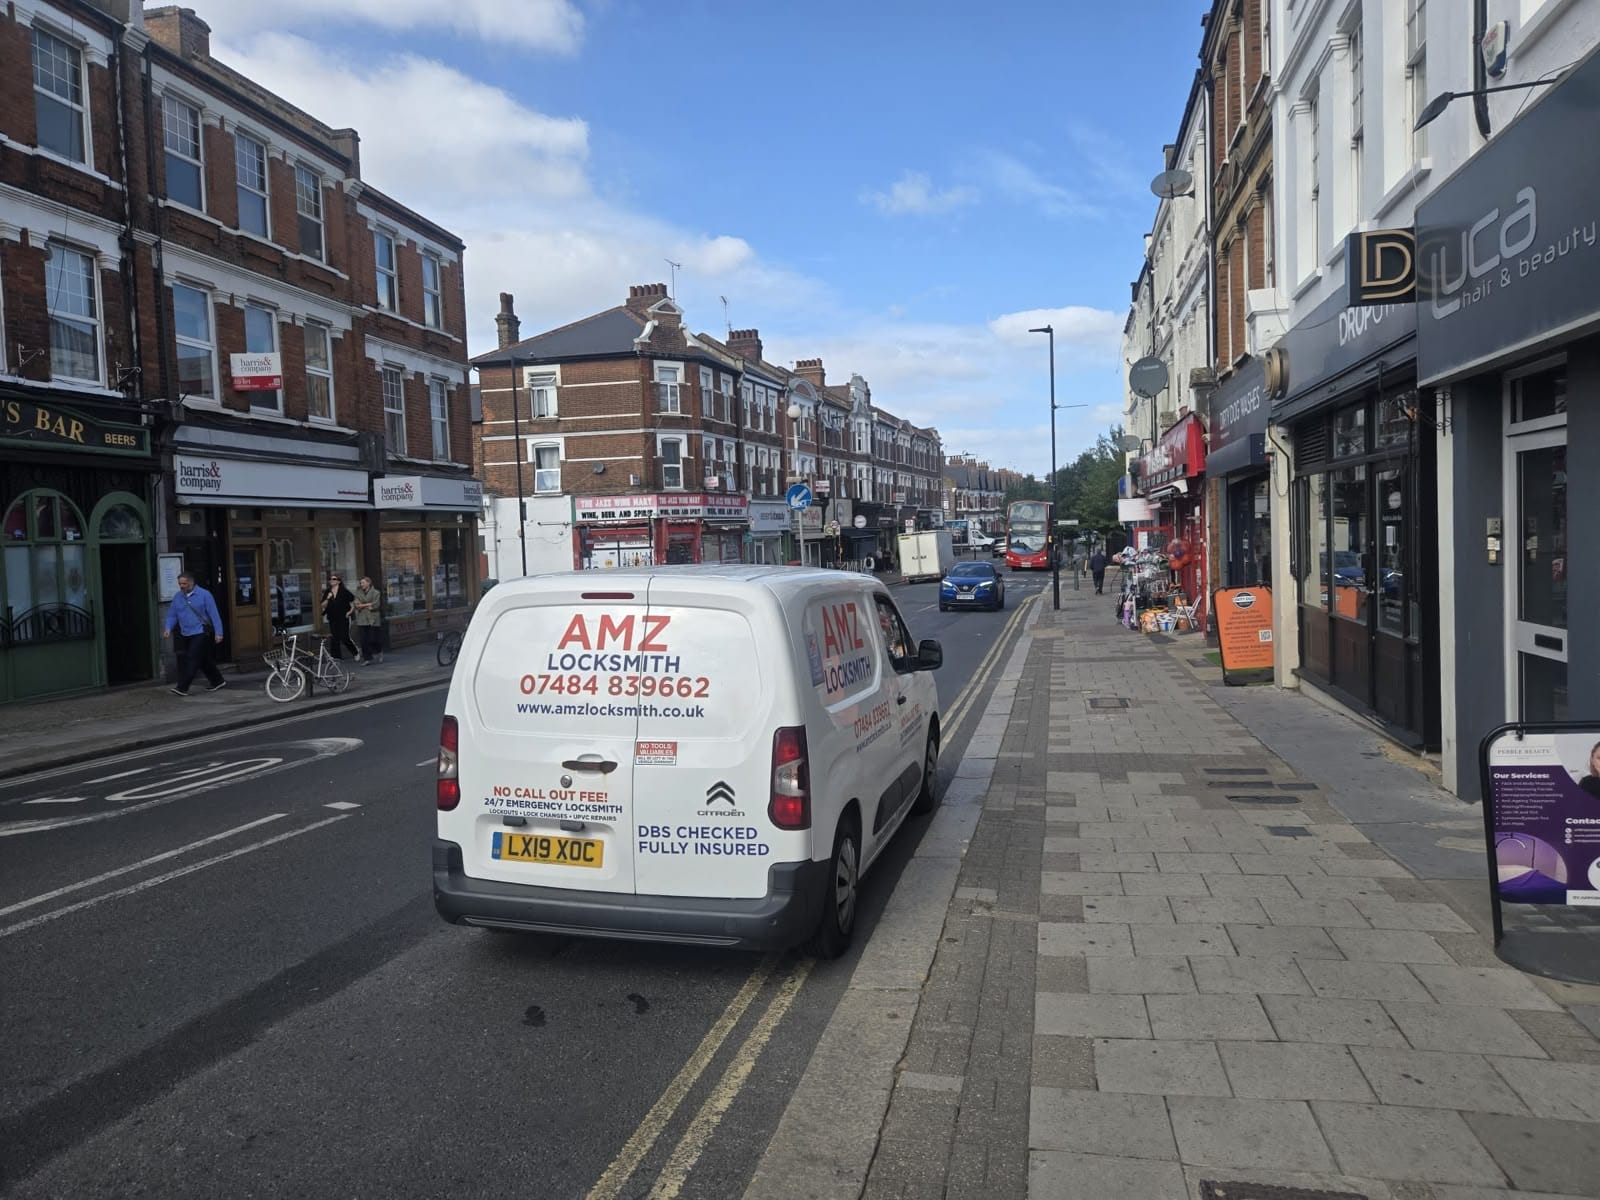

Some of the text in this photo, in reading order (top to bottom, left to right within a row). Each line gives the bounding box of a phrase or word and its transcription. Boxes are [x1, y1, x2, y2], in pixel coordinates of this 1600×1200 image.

[1462, 220, 1597, 308] hair & beauty
[34, 407, 85, 444] BAR
[104, 432, 137, 446] BEERS
[179, 476, 222, 492] company
[381, 493, 414, 503] company
[618, 510, 632, 518] AND
[557, 613, 671, 652] AMZ
[821, 602, 864, 659] AMZ
[547, 653, 681, 673] LOCKSMITH
[824, 655, 873, 694] LOCKSMITH
[520, 674, 710, 698] 07484 839662
[517, 703, 705, 718] www.amzlocksmith.co.uk
[493, 786, 608, 803] NO CALL OUT FEE!
[484, 797, 623, 814] 24/7 EMERGENCY LOCKSMITH
[489, 808, 518, 816] LOCKOUTS
[573, 813, 590, 821] UPVC
[638, 825, 758, 840] DBS CHECKED
[508, 835, 595, 863] LX19 XOC
[639, 841, 770, 856] FULLY INSURED
